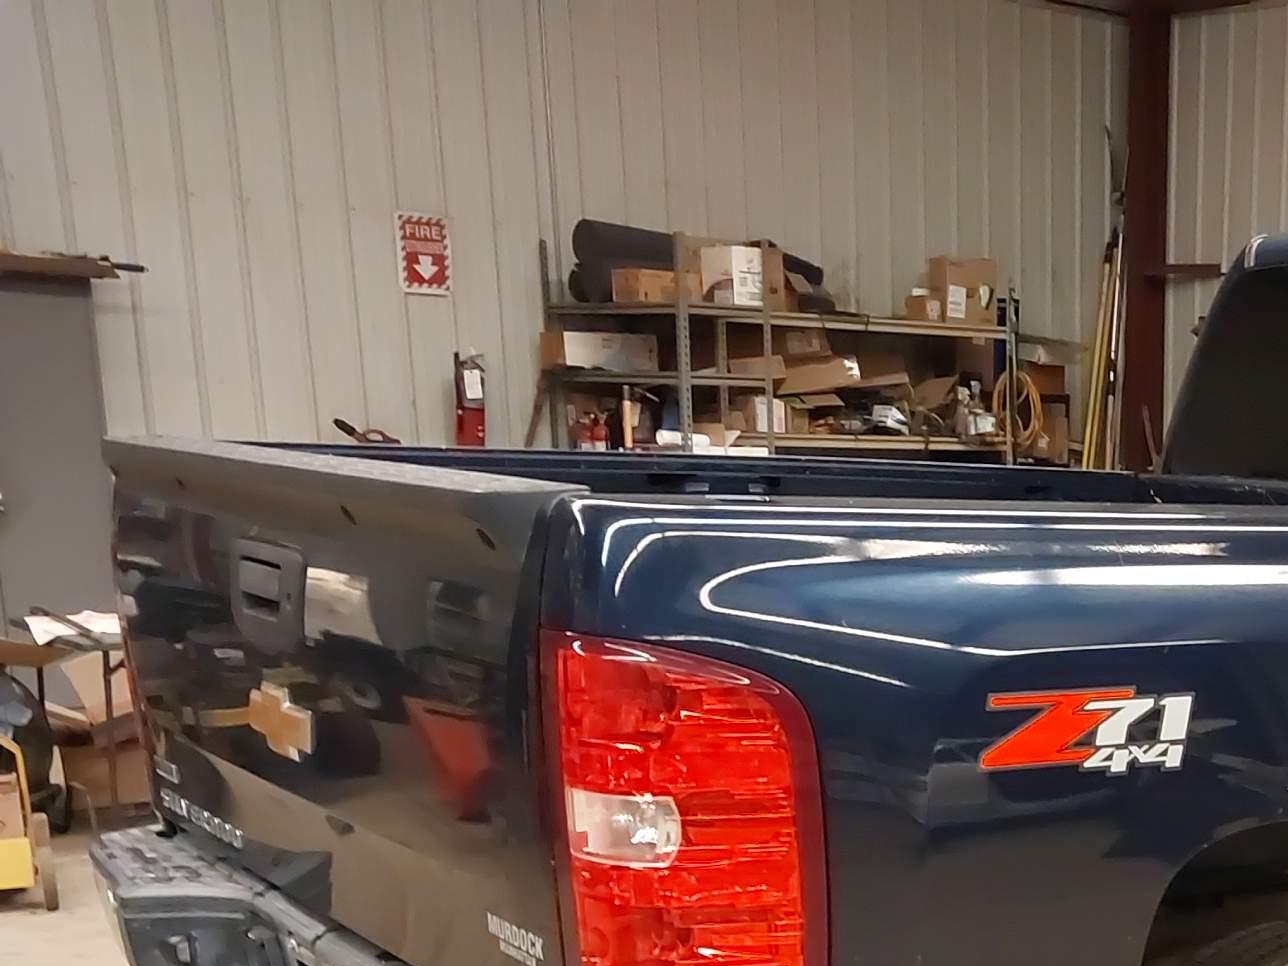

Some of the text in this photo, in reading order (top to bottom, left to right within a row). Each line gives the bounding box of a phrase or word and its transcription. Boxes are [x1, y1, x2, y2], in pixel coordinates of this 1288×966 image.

[404, 223, 443, 241] FIRE
[977, 686, 1195, 771] Z71
[486, 911, 544, 961] MURDOCK
